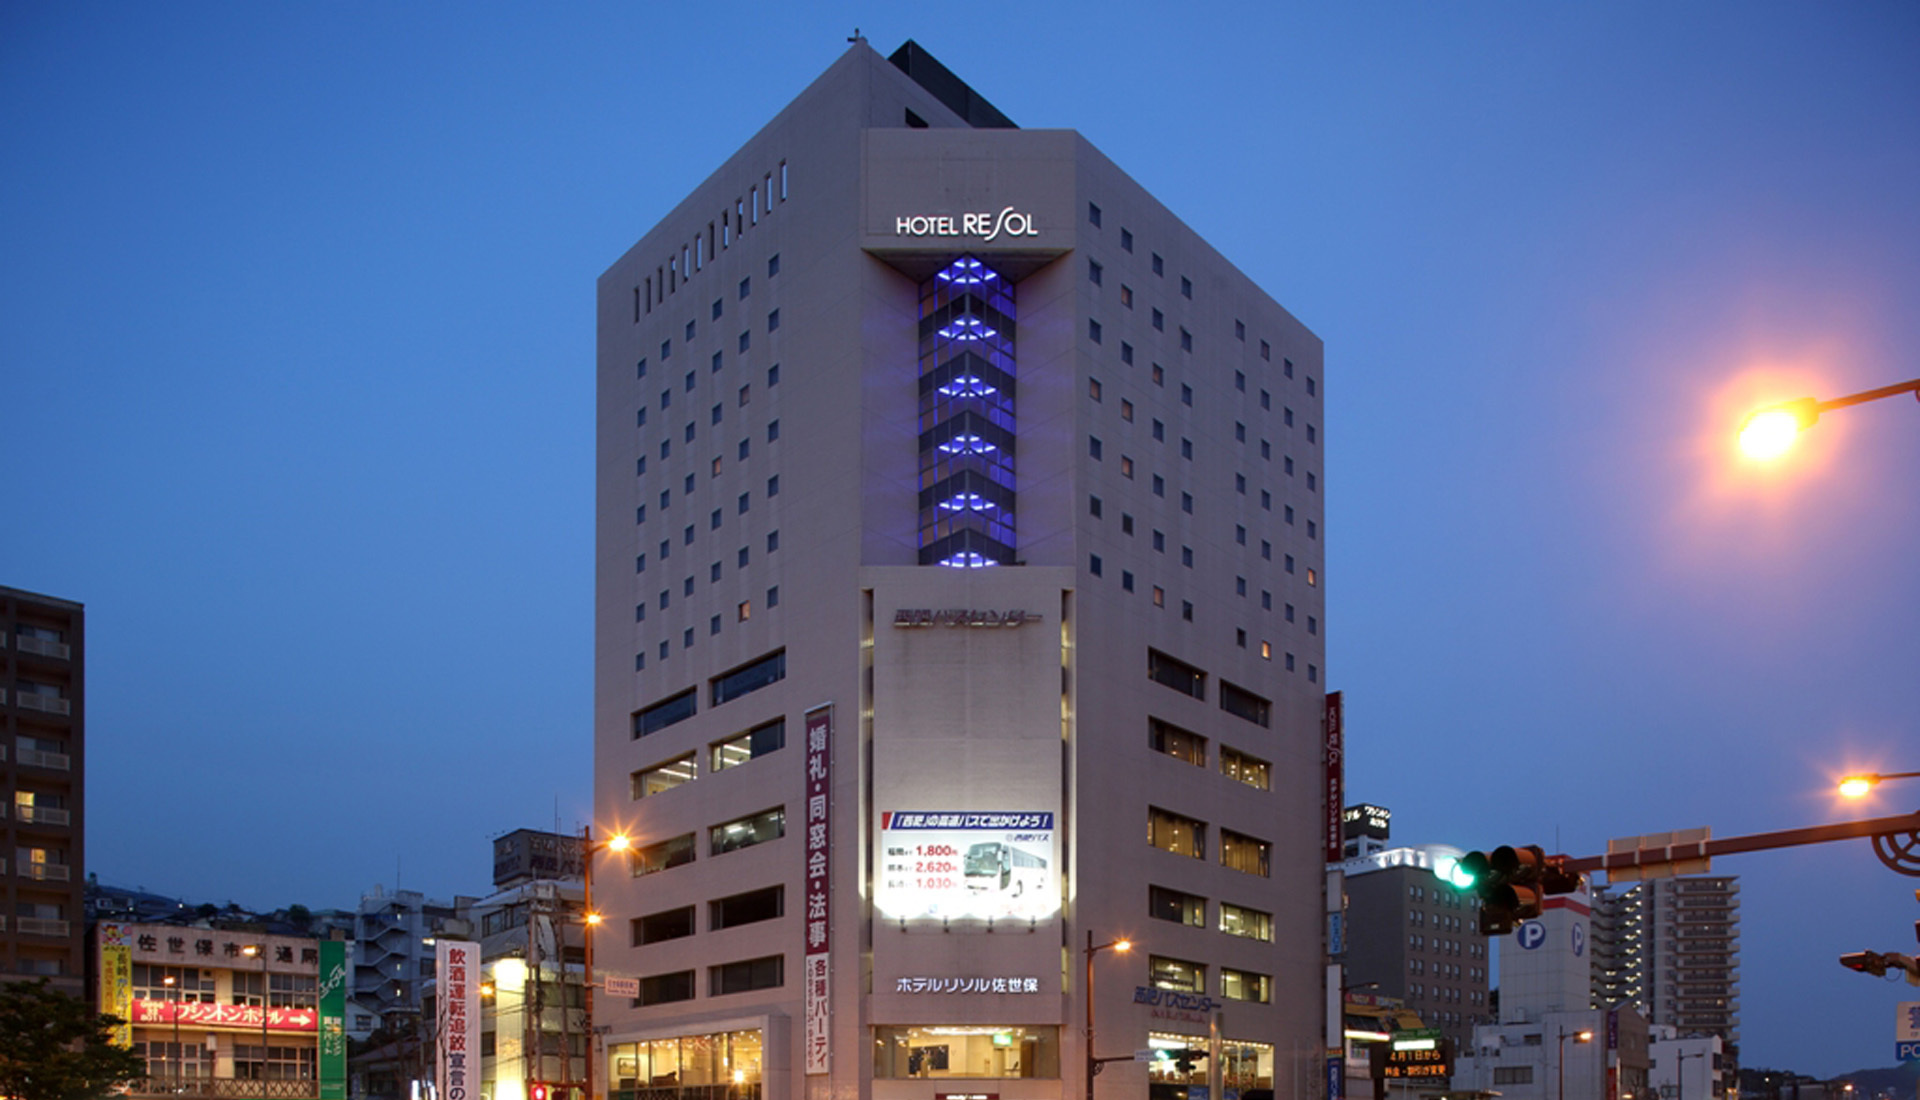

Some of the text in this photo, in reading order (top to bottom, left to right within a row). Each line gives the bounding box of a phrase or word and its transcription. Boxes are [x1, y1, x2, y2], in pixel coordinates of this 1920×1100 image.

[897, 206, 1038, 241] HOTEL RESOL
[809, 725, 826, 948] 婚礼・同窓会・法事
[449, 949, 466, 1100] 飲酒運転追放宣言の
[897, 977, 1038, 993] ホテルリソル佐世保
